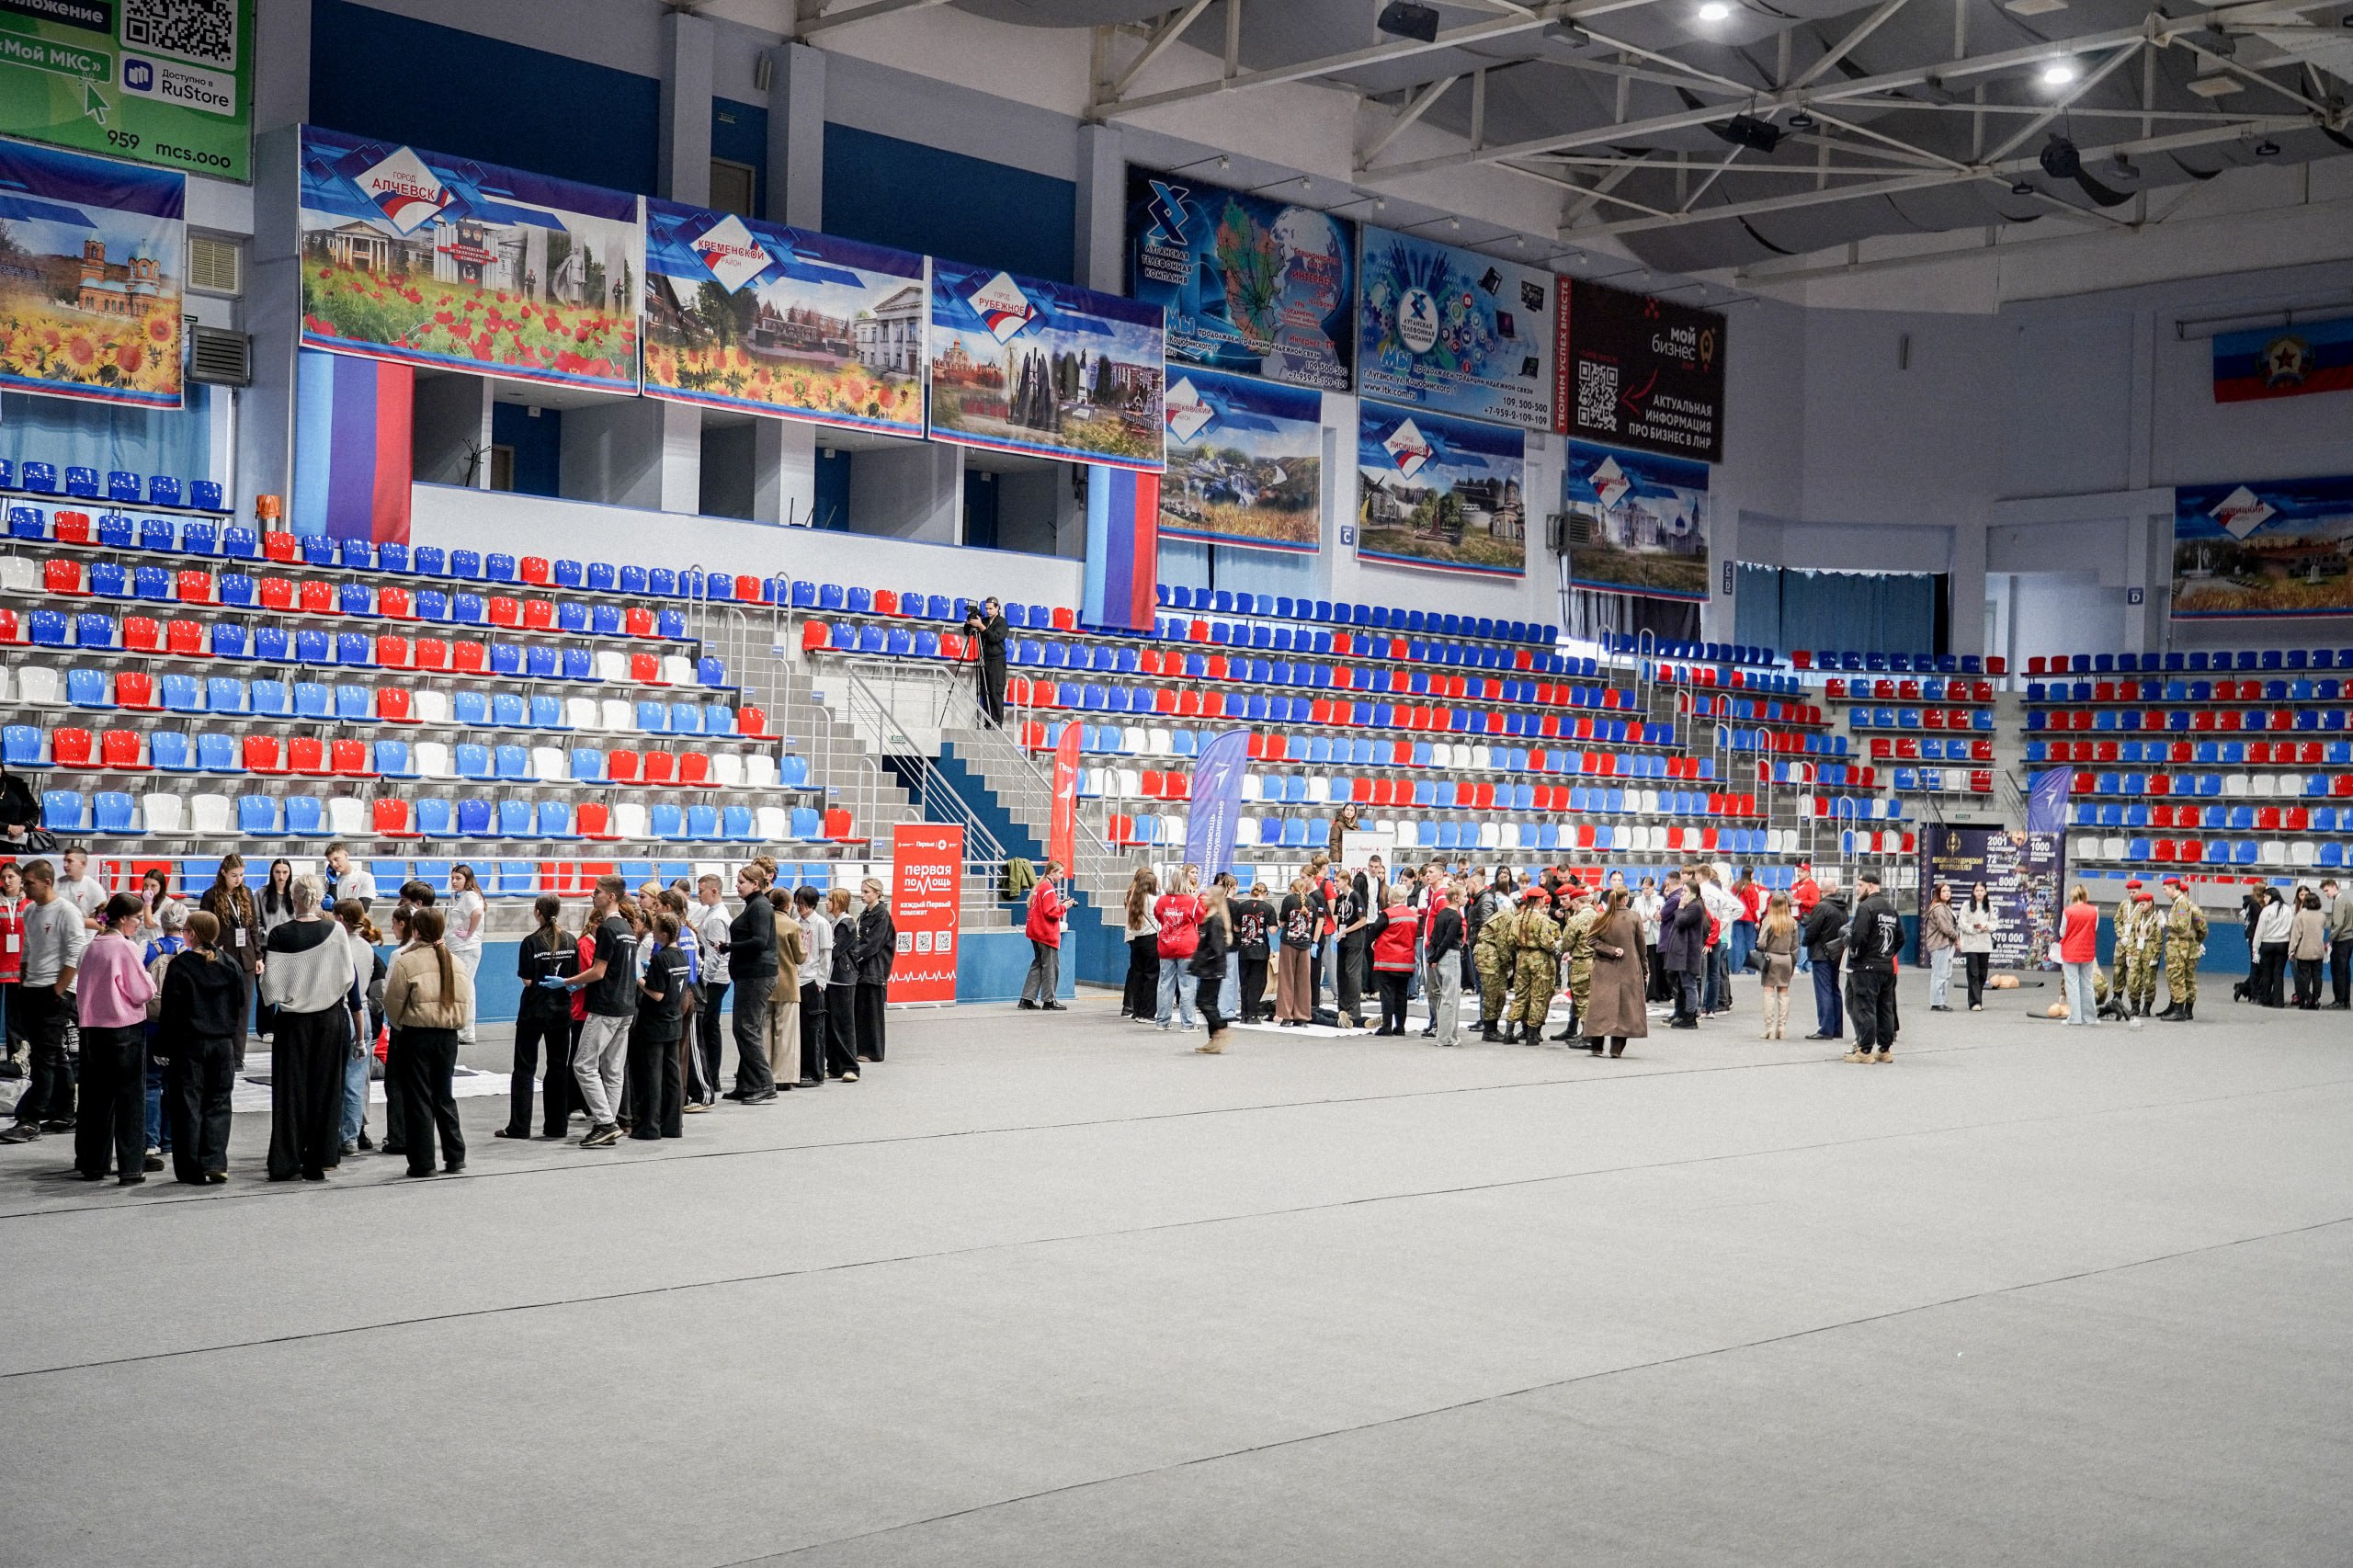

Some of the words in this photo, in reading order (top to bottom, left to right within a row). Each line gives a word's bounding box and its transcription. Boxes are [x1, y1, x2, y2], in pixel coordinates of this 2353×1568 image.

[50, 49, 102, 72] МКС»
[162, 69, 206, 86] Доступно
[162, 80, 229, 108] RuStore
[107, 130, 141, 150] 959
[155, 142, 232, 168] mcs.ooo
[392, 172, 416, 184] ГОРОД
[371, 177, 436, 200] АЛЧЕВСК
[699, 239, 765, 260] КРЕМЕНСКОЙ
[1145, 244, 1189, 261] ЛУГАНСКАЯ
[721, 257, 742, 267] РАЙОН
[1142, 254, 1193, 274] ТЕЛЕФОННАЯ
[1145, 267, 1188, 285] КОМПАНИЯ
[1291, 270, 1334, 287] ИНТЕРНЕТ
[994, 291, 1011, 301] ГОРОД
[979, 297, 1025, 314] РУБЕЖНОЕ
[1165, 308, 1195, 335] Мы
[1403, 318, 1433, 329] ЛУГАНСКАЯ
[1670, 326, 1696, 346] мой
[1559, 333, 1567, 371] УСПЕХ
[1652, 334, 1696, 360] бизнес
[1381, 344, 1413, 371] Мы
[1321, 363, 1348, 377] 500-500
[1363, 382, 1416, 400] www.ltk.com.ru
[1518, 399, 1548, 414] 500-500
[1558, 375, 1566, 428] ТВОРИМ
[1653, 393, 1712, 417] АКТУАЛЬНАЯ
[1484, 406, 1547, 426] +7-959-2-109-109
[1645, 409, 1711, 434] ИНФОРМАЦИЯ
[1629, 423, 1649, 437] ПРО
[1650, 426, 1685, 445] БИЗНЕС
[1686, 434, 1691, 446] В
[1692, 435, 1711, 449] ЛНР
[2132, 593, 2141, 603] D
[1987, 835, 2007, 846] 2001
[2030, 842, 2051, 851] 1000
[1986, 854, 1996, 864] 72
[904, 865, 952, 879] первая
[1998, 876, 2018, 887] 8000
[2008, 932, 2024, 943] 000
